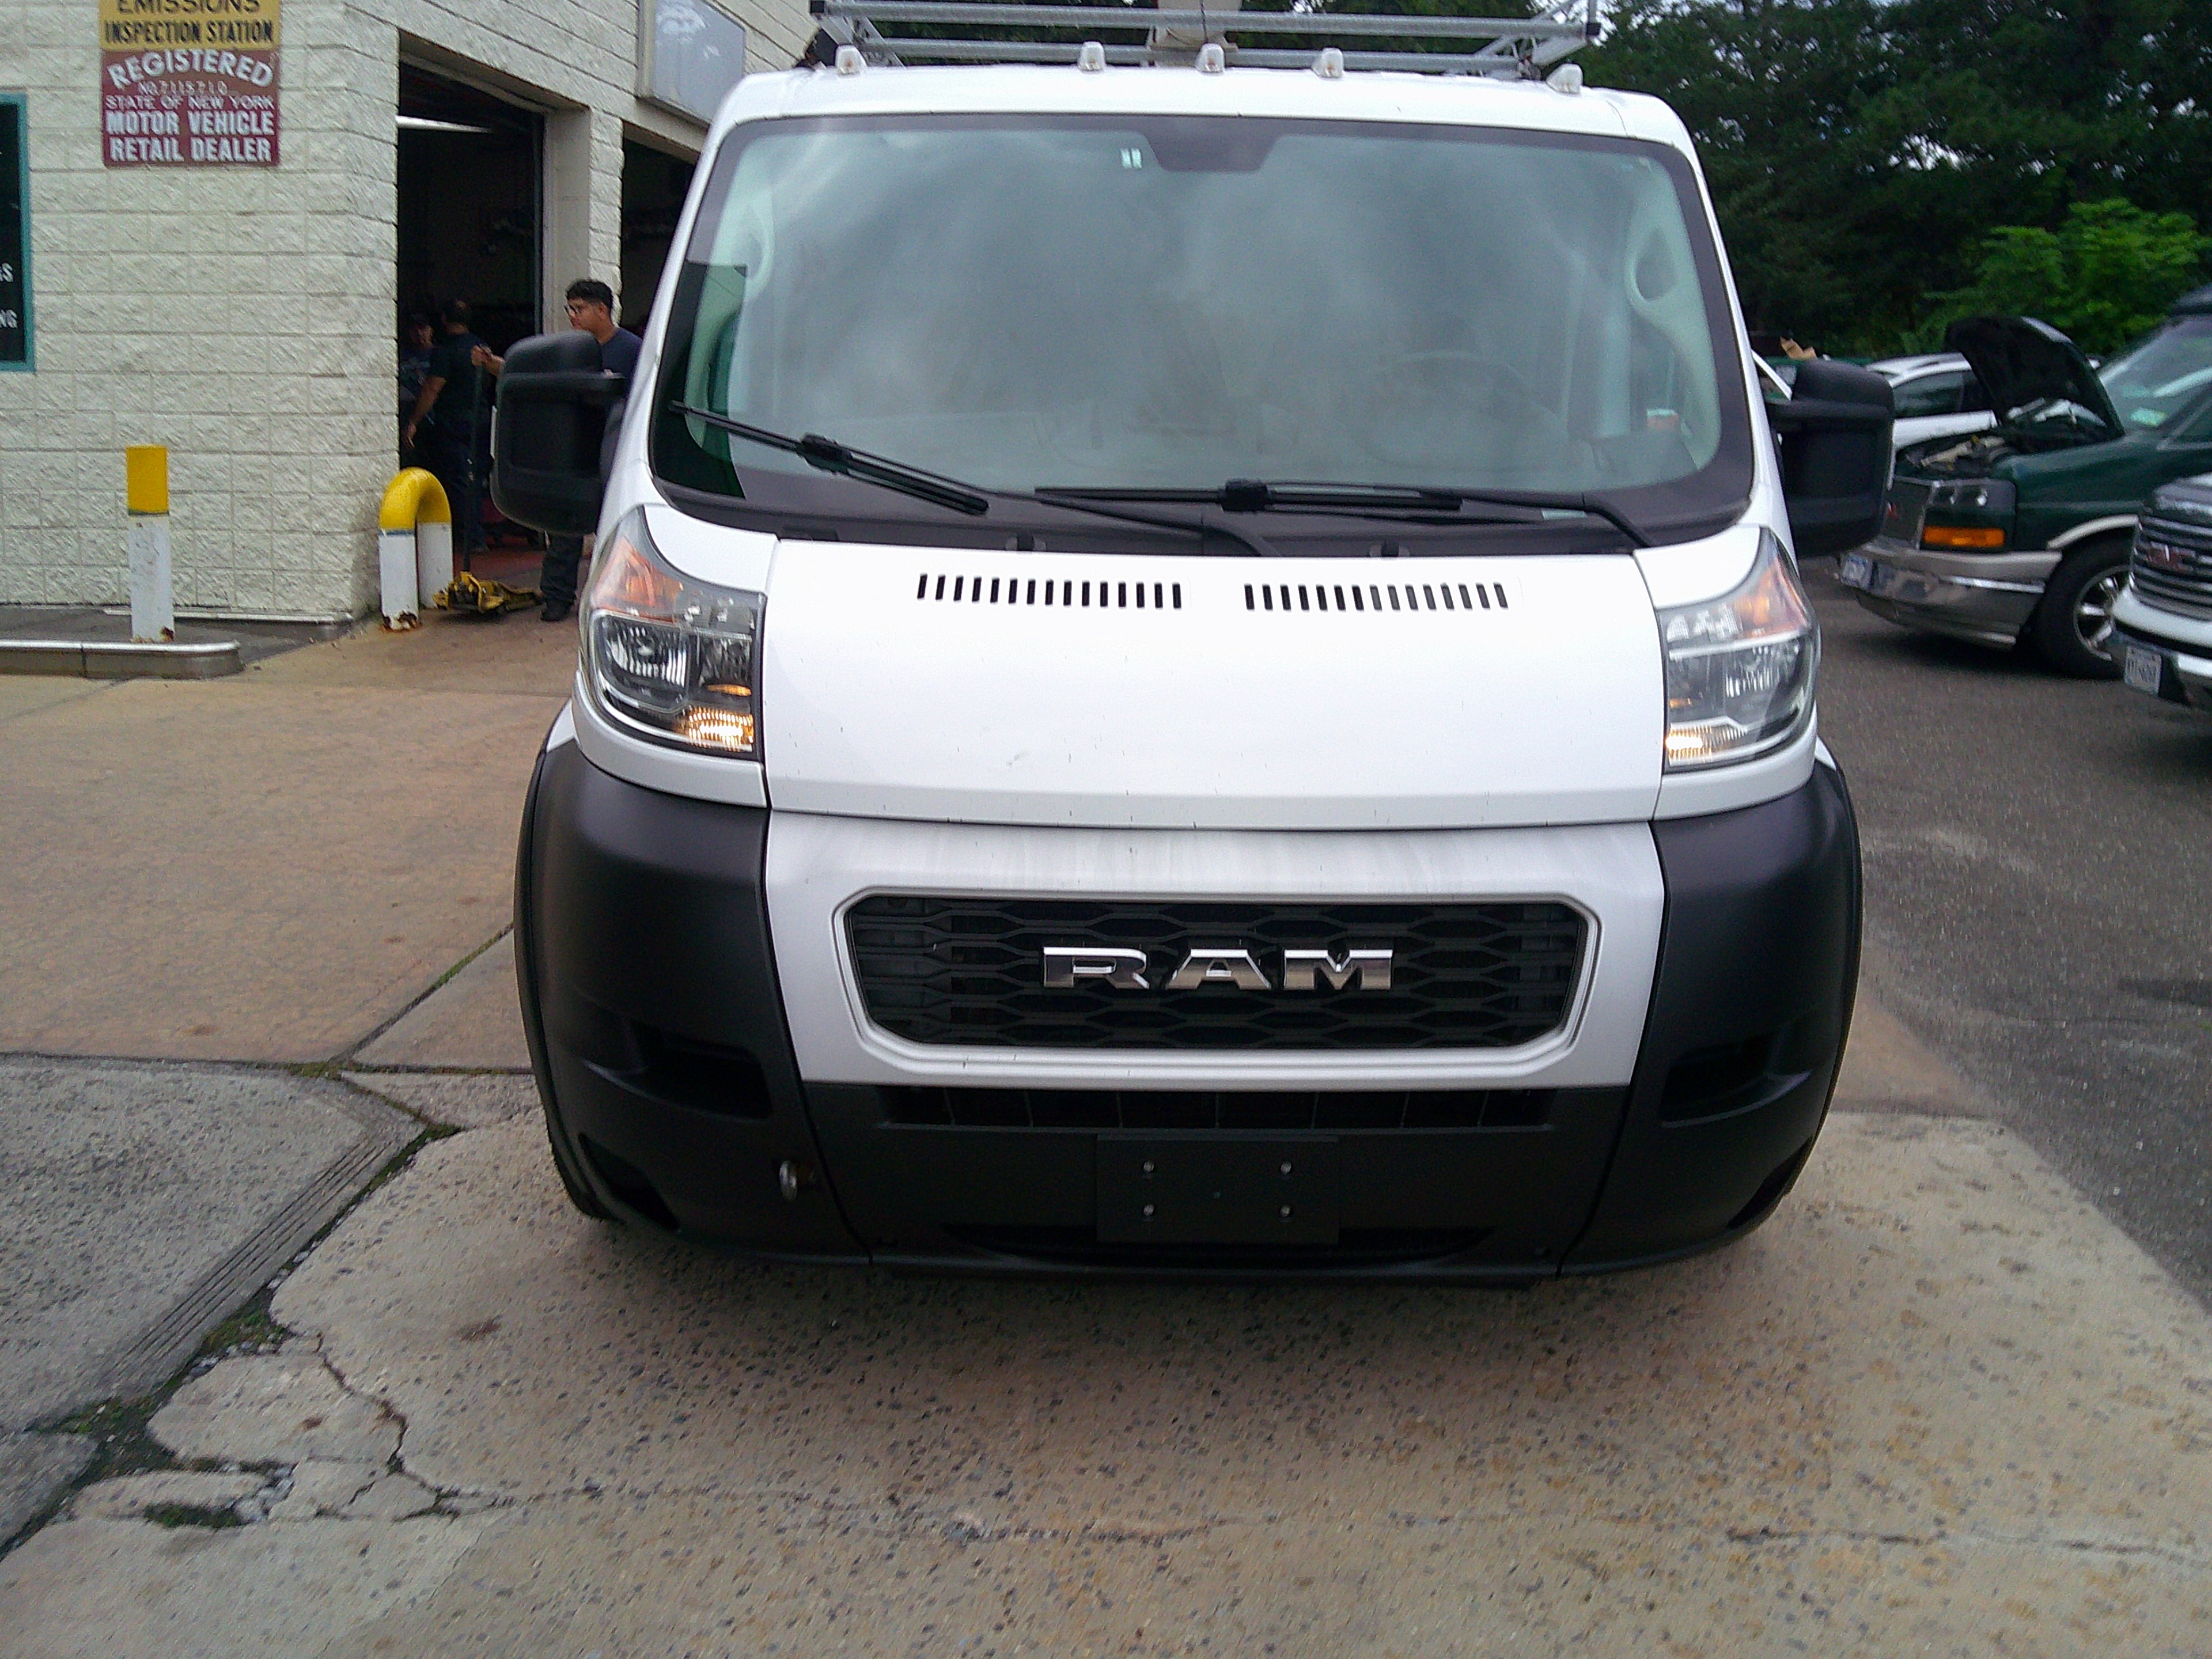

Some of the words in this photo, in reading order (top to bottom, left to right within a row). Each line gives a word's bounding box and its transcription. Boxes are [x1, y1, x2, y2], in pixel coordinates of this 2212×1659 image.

[118, 0, 261, 13] EMISSIONS
[105, 20, 202, 43] INSPECTION
[207, 19, 274, 43] STATION
[107, 48, 274, 90] REGISTERED
[105, 95, 156, 110] STATE
[160, 95, 184, 110] OF
[188, 95, 225, 109] NEW
[228, 95, 275, 109] YORK
[105, 109, 180, 135] MOTOR
[187, 109, 275, 136] VEHICLE
[109, 136, 184, 162] RETAIL
[190, 136, 272, 162] DEALER
[1043, 946, 1394, 991] RAM
